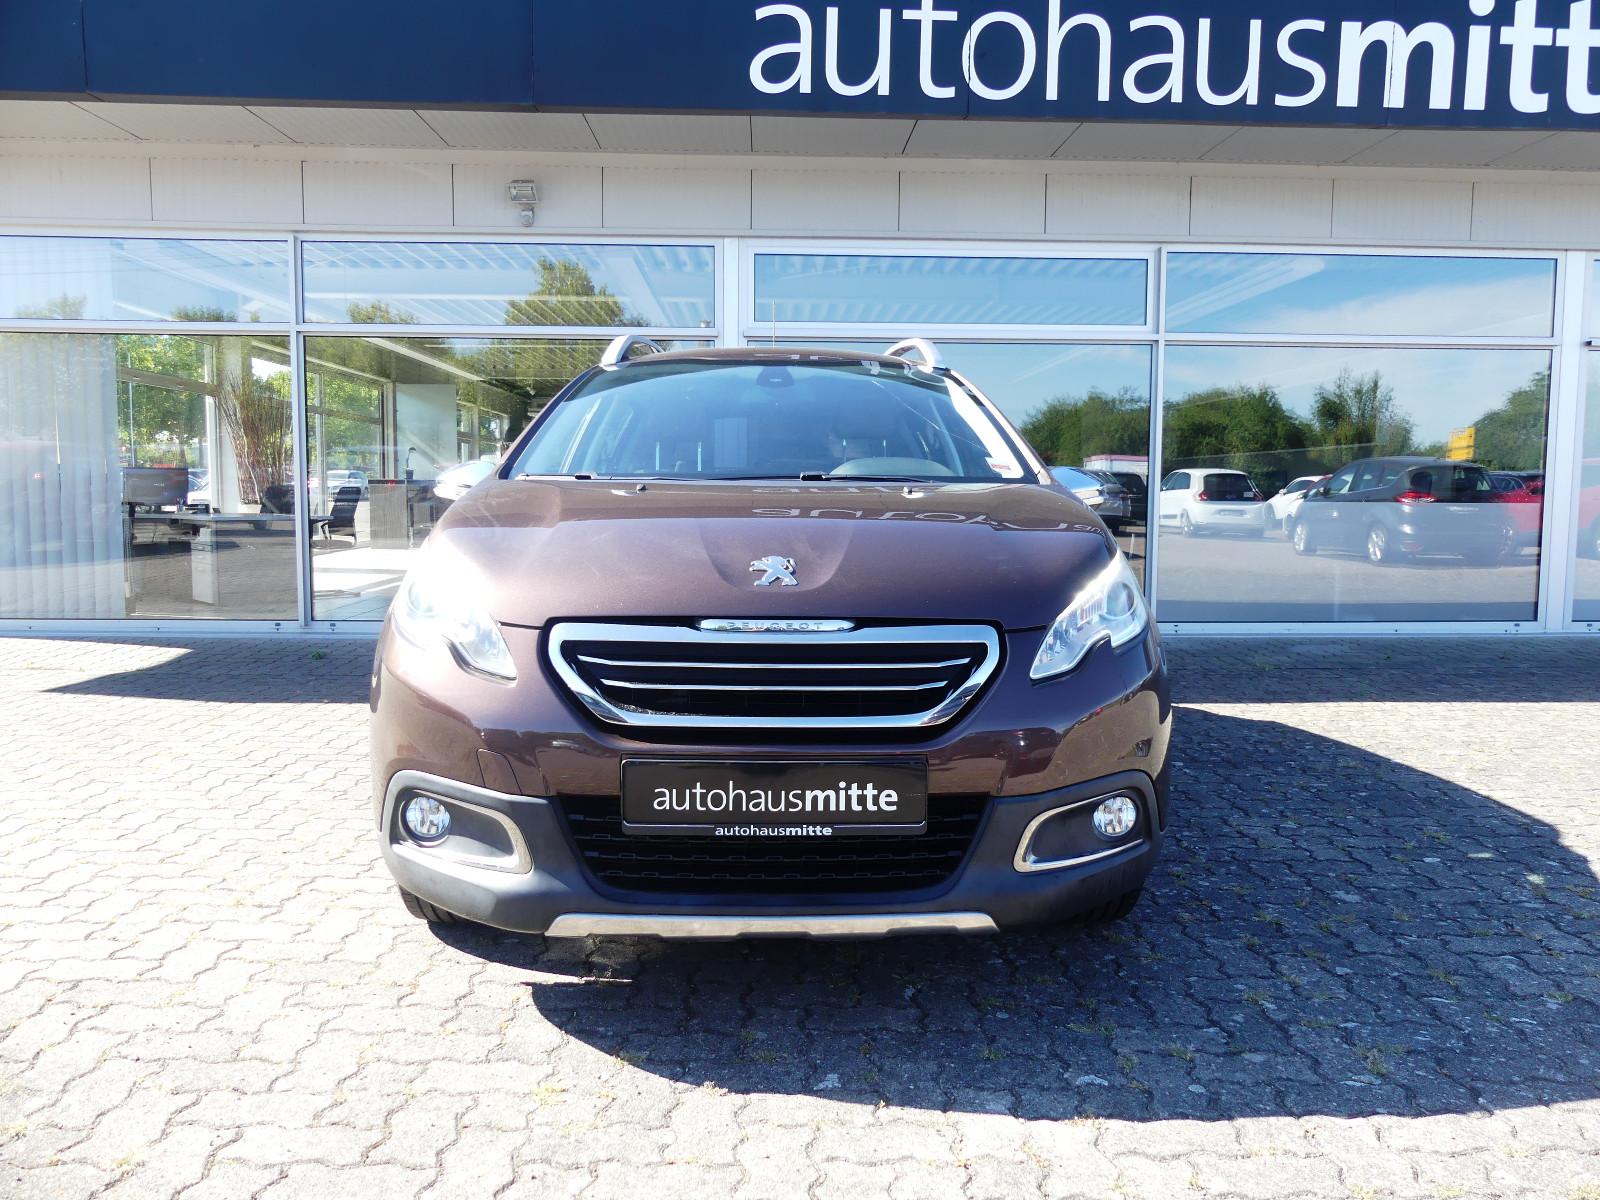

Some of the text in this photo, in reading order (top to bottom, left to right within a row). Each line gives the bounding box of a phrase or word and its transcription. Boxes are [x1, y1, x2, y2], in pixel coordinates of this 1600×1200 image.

[726, 621, 824, 631] PEUGEOT
[653, 780, 899, 812] autohausmitte
[714, 824, 834, 837] autohausmitte
